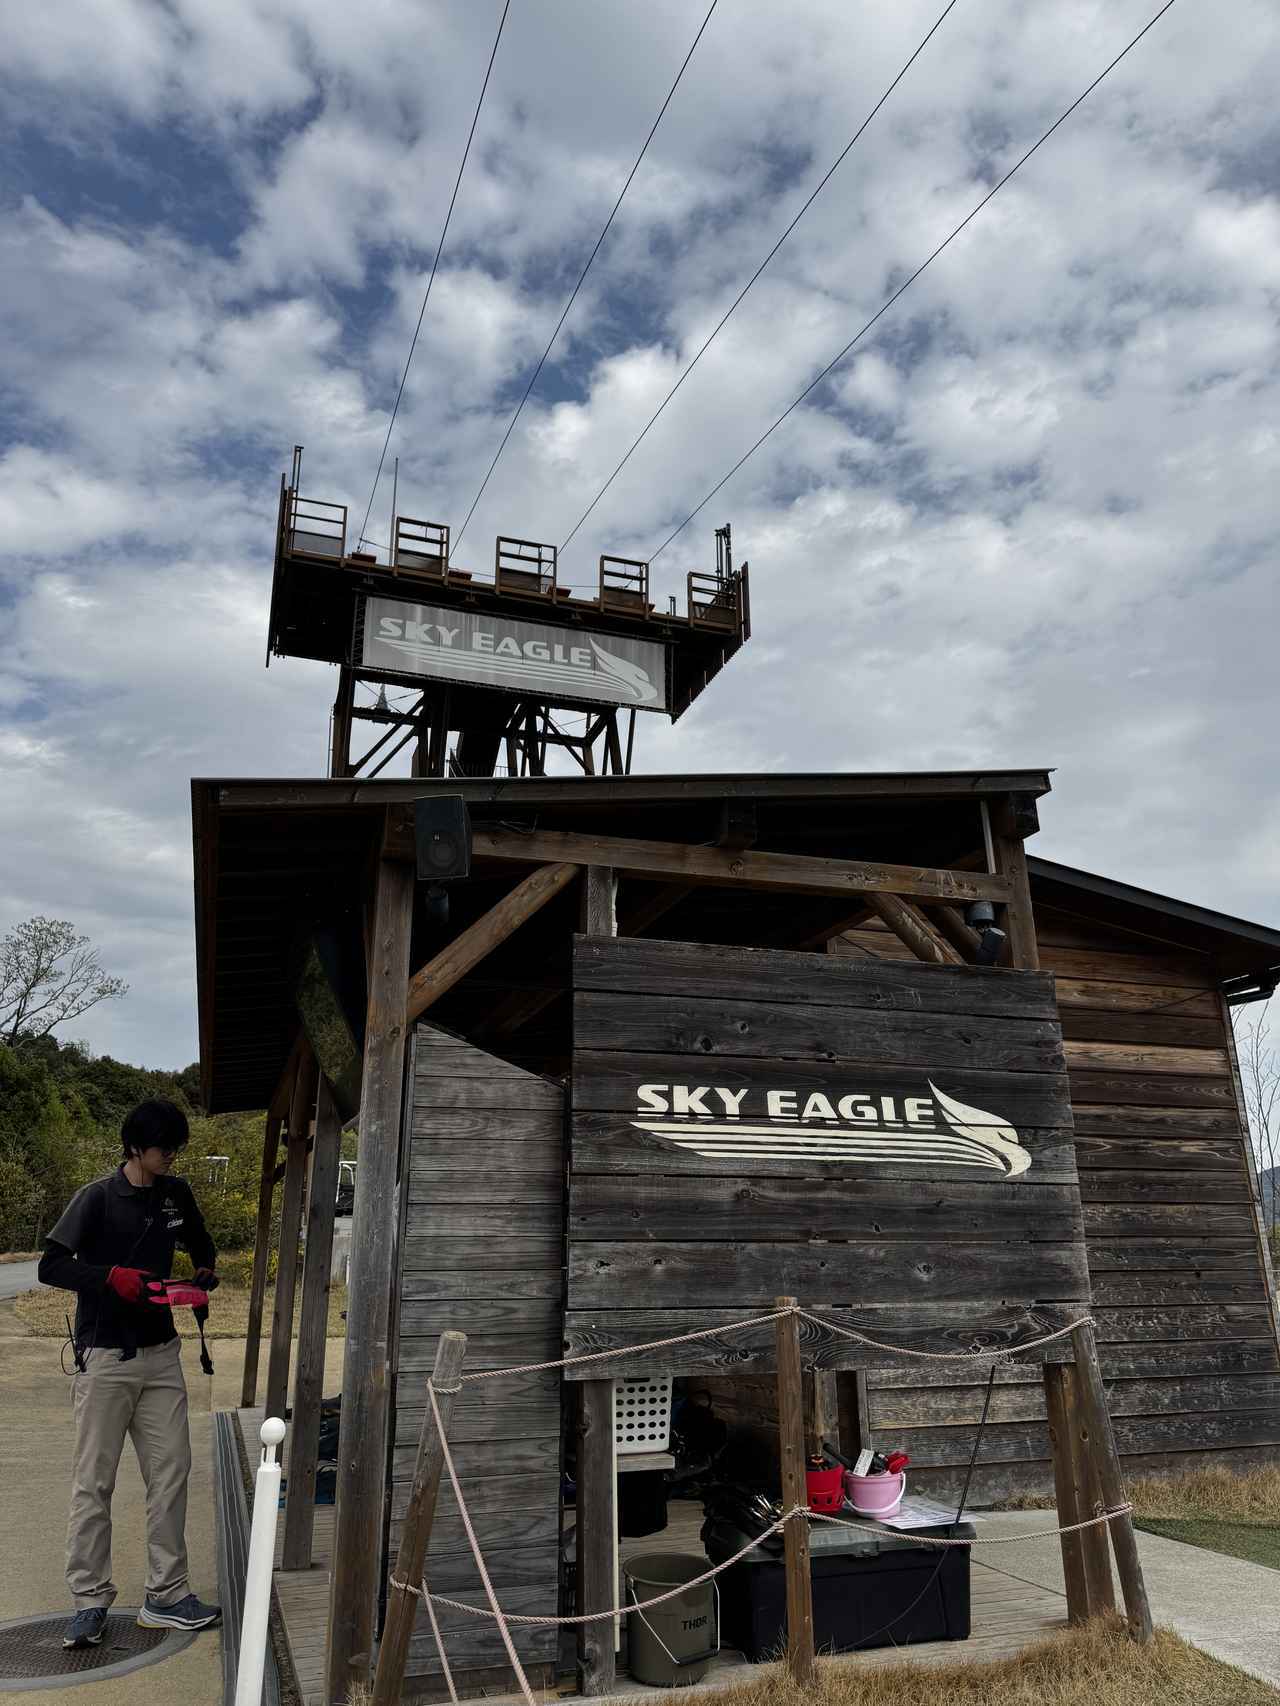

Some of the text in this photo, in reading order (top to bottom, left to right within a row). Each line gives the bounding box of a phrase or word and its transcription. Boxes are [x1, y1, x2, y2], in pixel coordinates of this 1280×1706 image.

[379, 617, 592, 666] SKY EAGLE
[637, 1084, 936, 1129] SKY EAGLE
[681, 1616, 707, 1631] THOR
